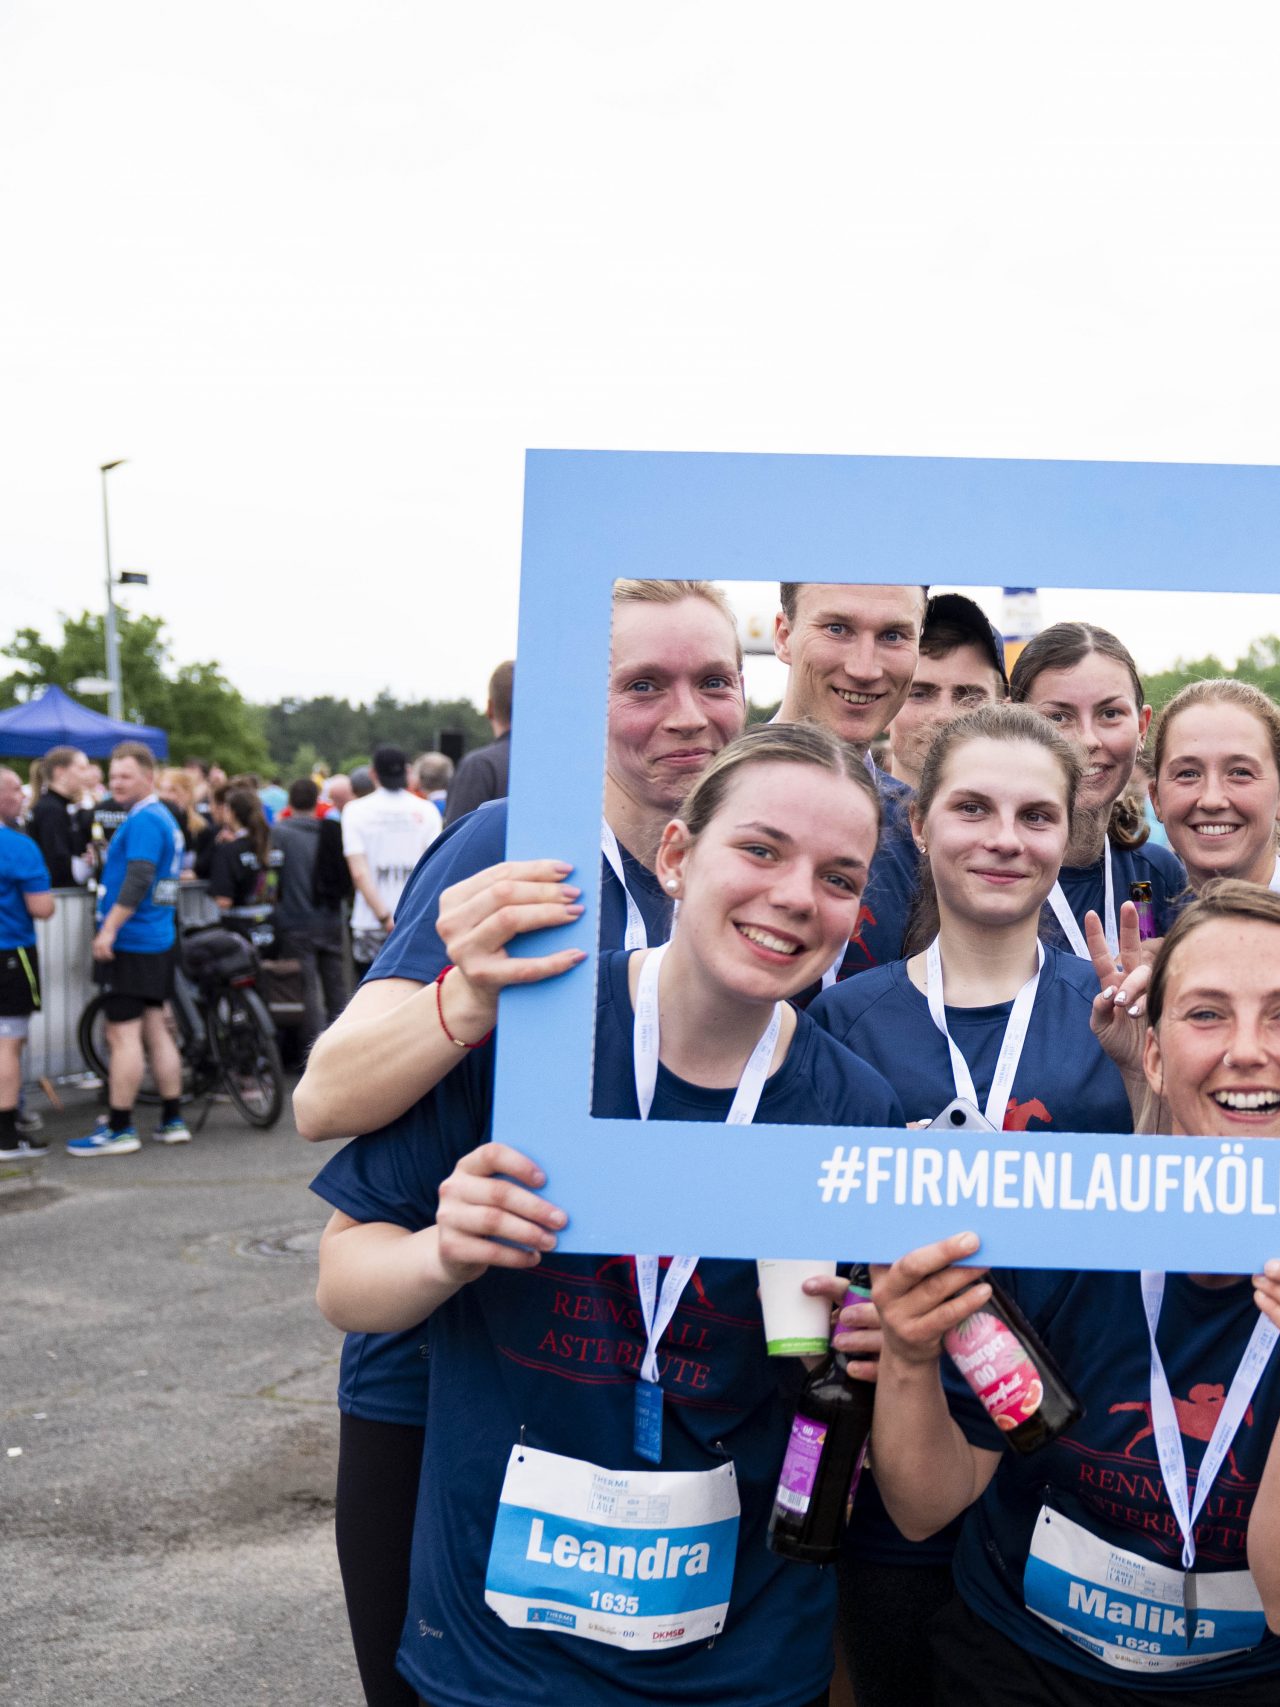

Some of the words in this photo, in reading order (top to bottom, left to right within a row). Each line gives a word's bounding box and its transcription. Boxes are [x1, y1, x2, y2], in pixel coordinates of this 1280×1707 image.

[593, 1473, 630, 1488] THERME
[590, 1498, 613, 1515] LAUF
[525, 1517, 711, 1581] Leandra
[1111, 1552, 1146, 1571] THERME
[589, 1590, 640, 1615] 1635
[1067, 1581, 1216, 1639] Malika
[652, 1629, 678, 1640] DKMS
[1114, 1634, 1161, 1654] 1626
